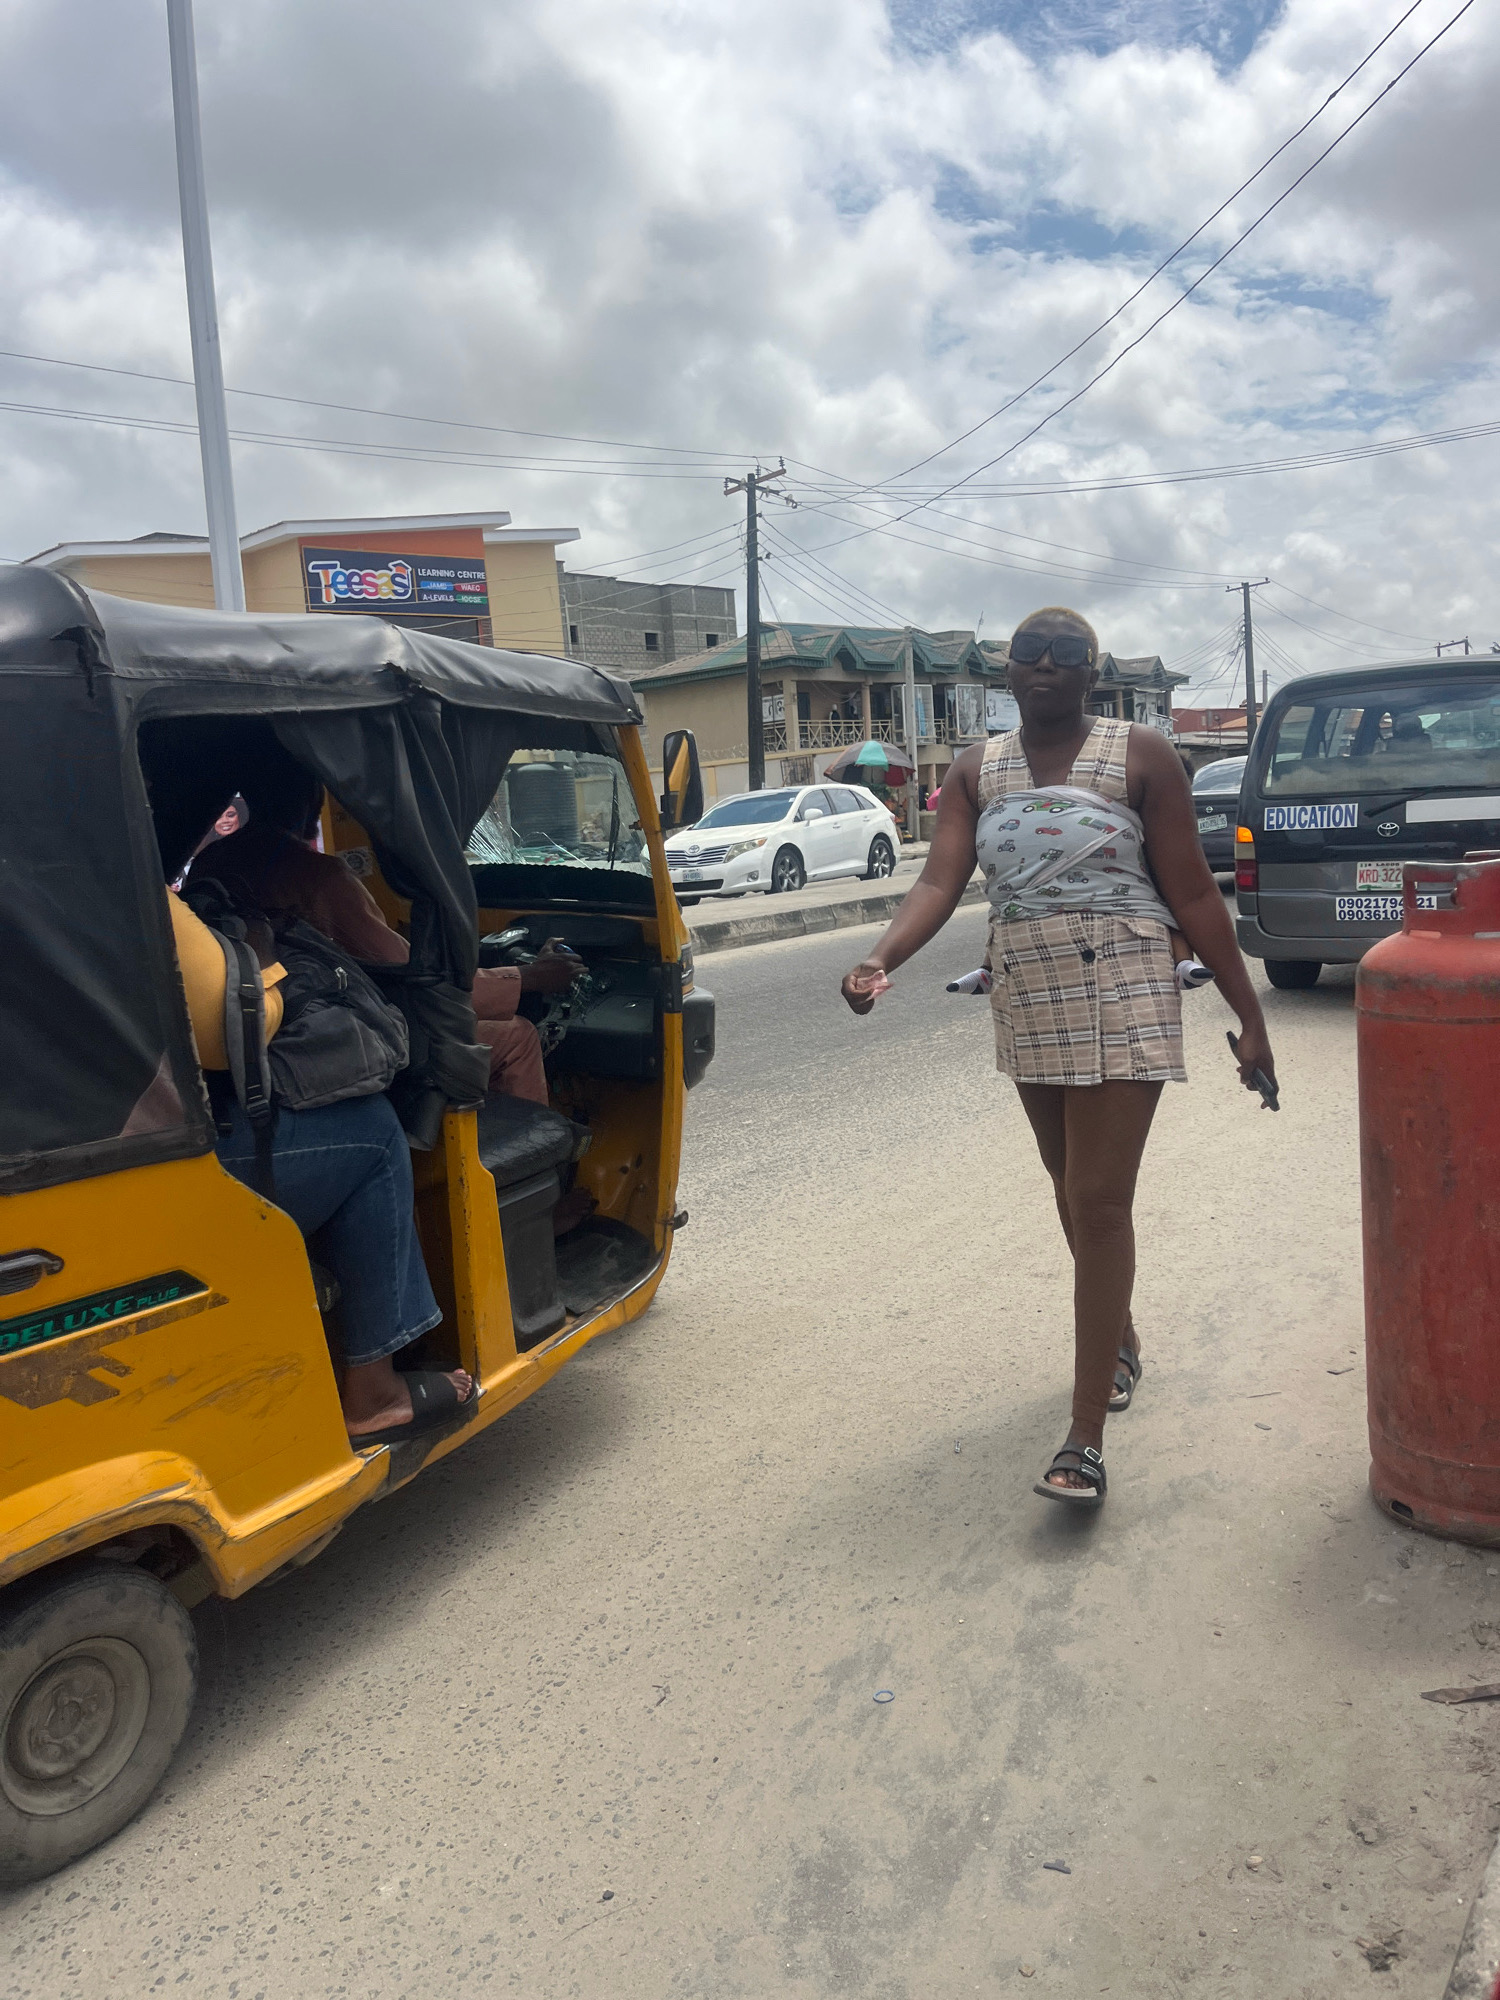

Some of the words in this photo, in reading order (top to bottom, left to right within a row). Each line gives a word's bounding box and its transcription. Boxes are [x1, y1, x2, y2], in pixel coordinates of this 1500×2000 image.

[417, 568, 456, 578] LEARNING
[457, 570, 486, 579] CENTRE
[308, 560, 413, 604] Teesas
[460, 583, 481, 592] WAEC
[422, 593, 455, 602] A-LEVELS
[1266, 804, 1357, 830] EDUCATION
[1358, 868, 1402, 883] KRD-322
[1338, 897, 1435, 909] 0902179421
[1338, 909, 1405, 920] 09036109
[0, 1295, 135, 1350] DELUXE
[136, 1286, 180, 1309] PLUS
